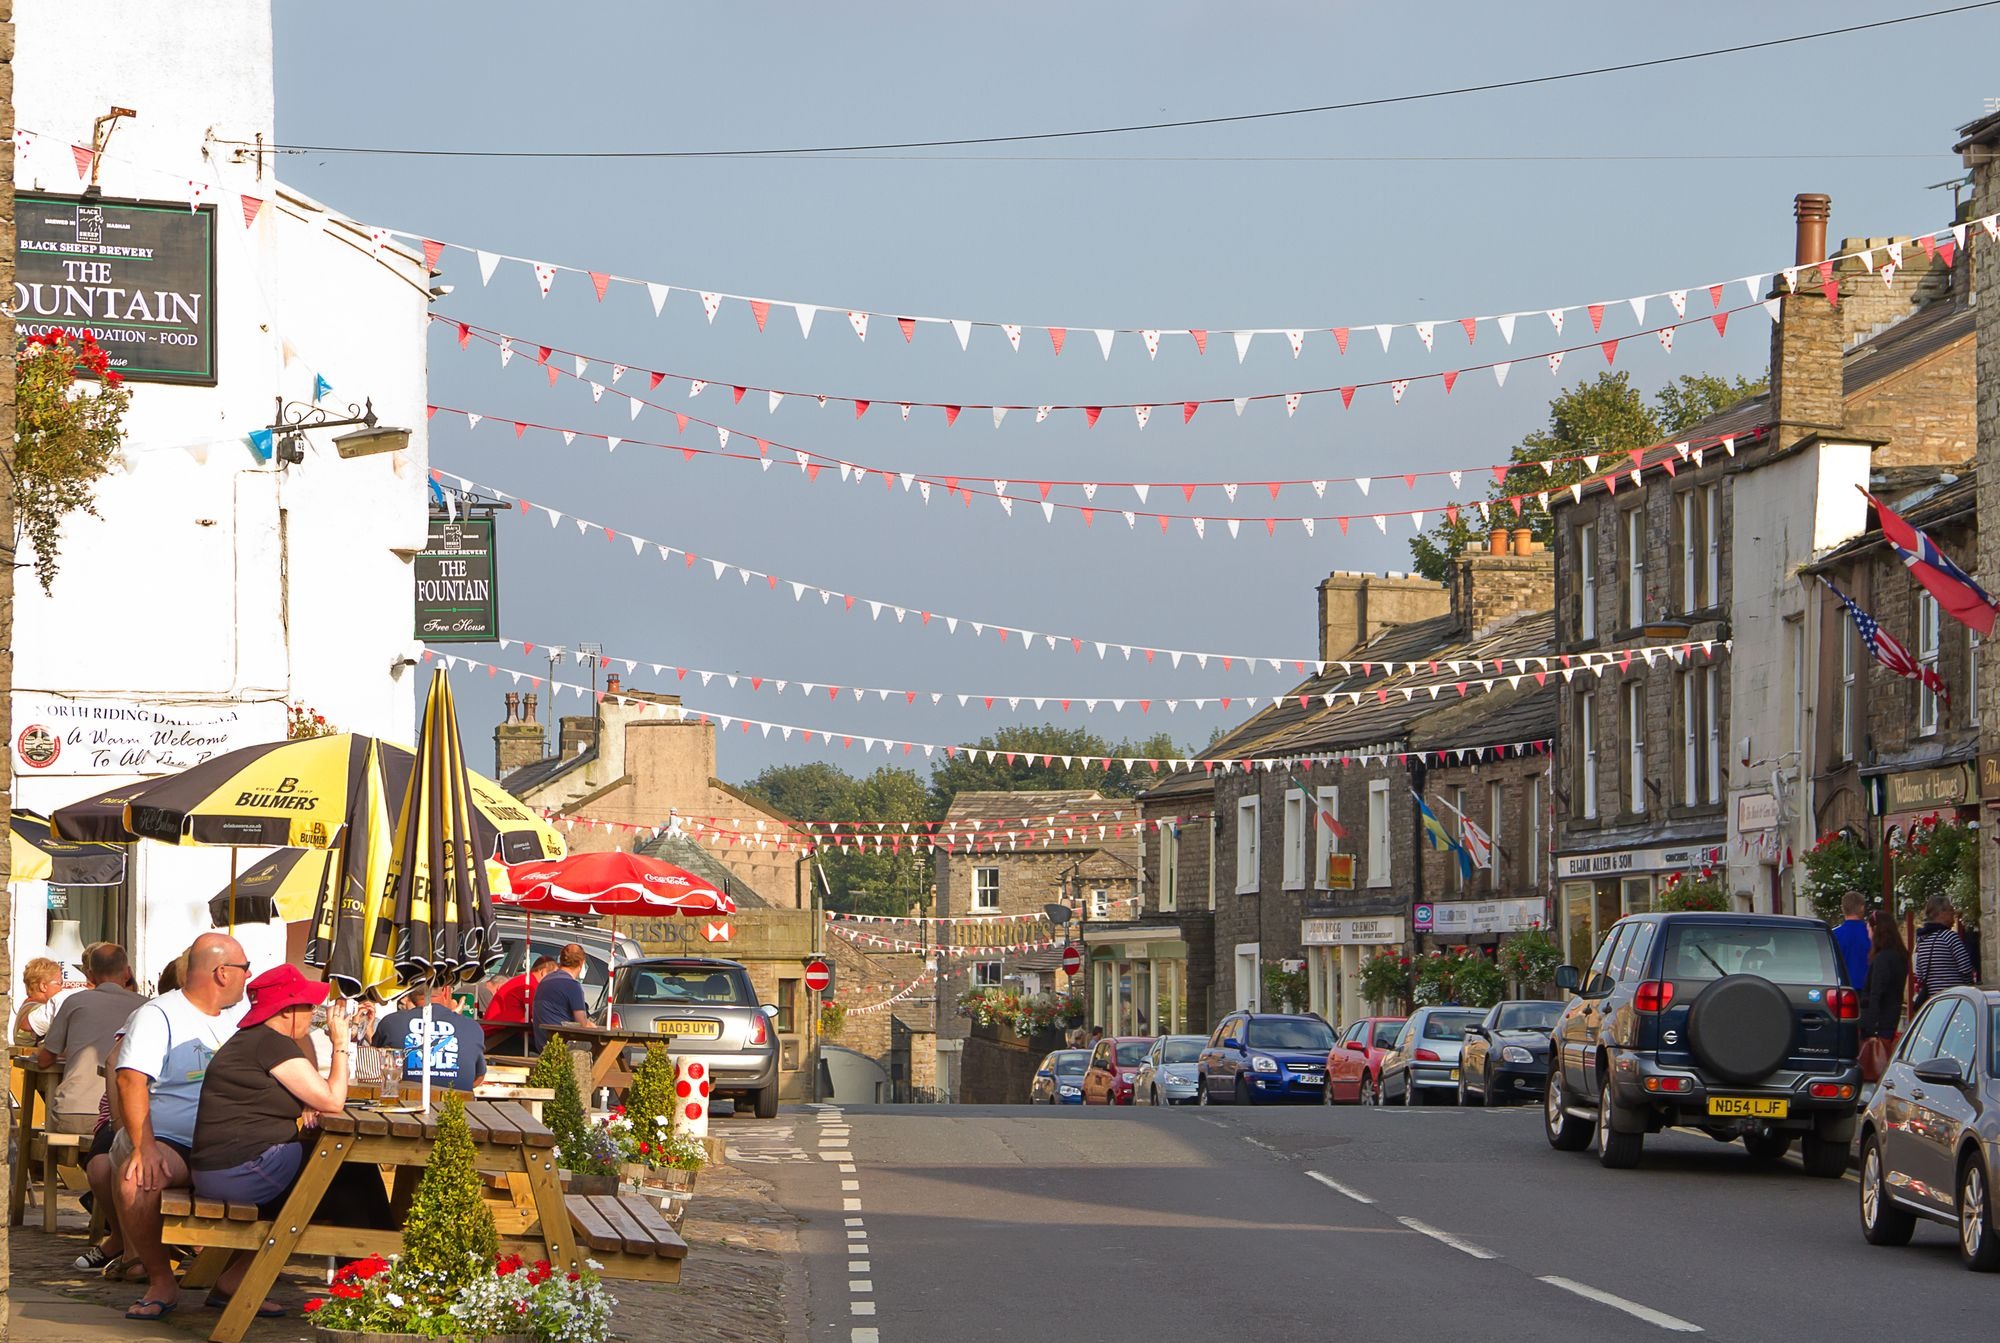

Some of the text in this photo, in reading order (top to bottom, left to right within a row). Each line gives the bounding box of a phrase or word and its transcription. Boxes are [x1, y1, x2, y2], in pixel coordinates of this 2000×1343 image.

[20, 239, 154, 258] BLACK SHEEP BREWERY
[62, 260, 112, 285] THE
[14, 281, 202, 325] OUNTAIN
[160, 333, 198, 346] FOOD
[438, 560, 468, 577] THE
[416, 579, 489, 602] FOUNTAIN
[423, 618, 486, 632] Free House
[41, 705, 88, 718] ORTH
[93, 707, 149, 721] RIDING
[67, 726, 82, 746] A
[89, 727, 140, 746] Warm
[150, 729, 229, 747] Welcome
[91, 749, 111, 768] To
[119, 748, 148, 767] All
[235, 791, 320, 811] BULMERS
[1569, 859, 1591, 874] ELIJAH
[1592, 856, 1611, 873] ALLEN
[1619, 853, 1632, 869] SON
[644, 873, 691, 887] Coca-Cola
[629, 921, 698, 943] HSBC
[955, 922, 1051, 946] HERRIOT'S
[1352, 920, 1379, 932] CHEMIST
[659, 1022, 715, 1034] DA03 UYW
[1715, 1099, 1781, 1114] ND54 LJF
